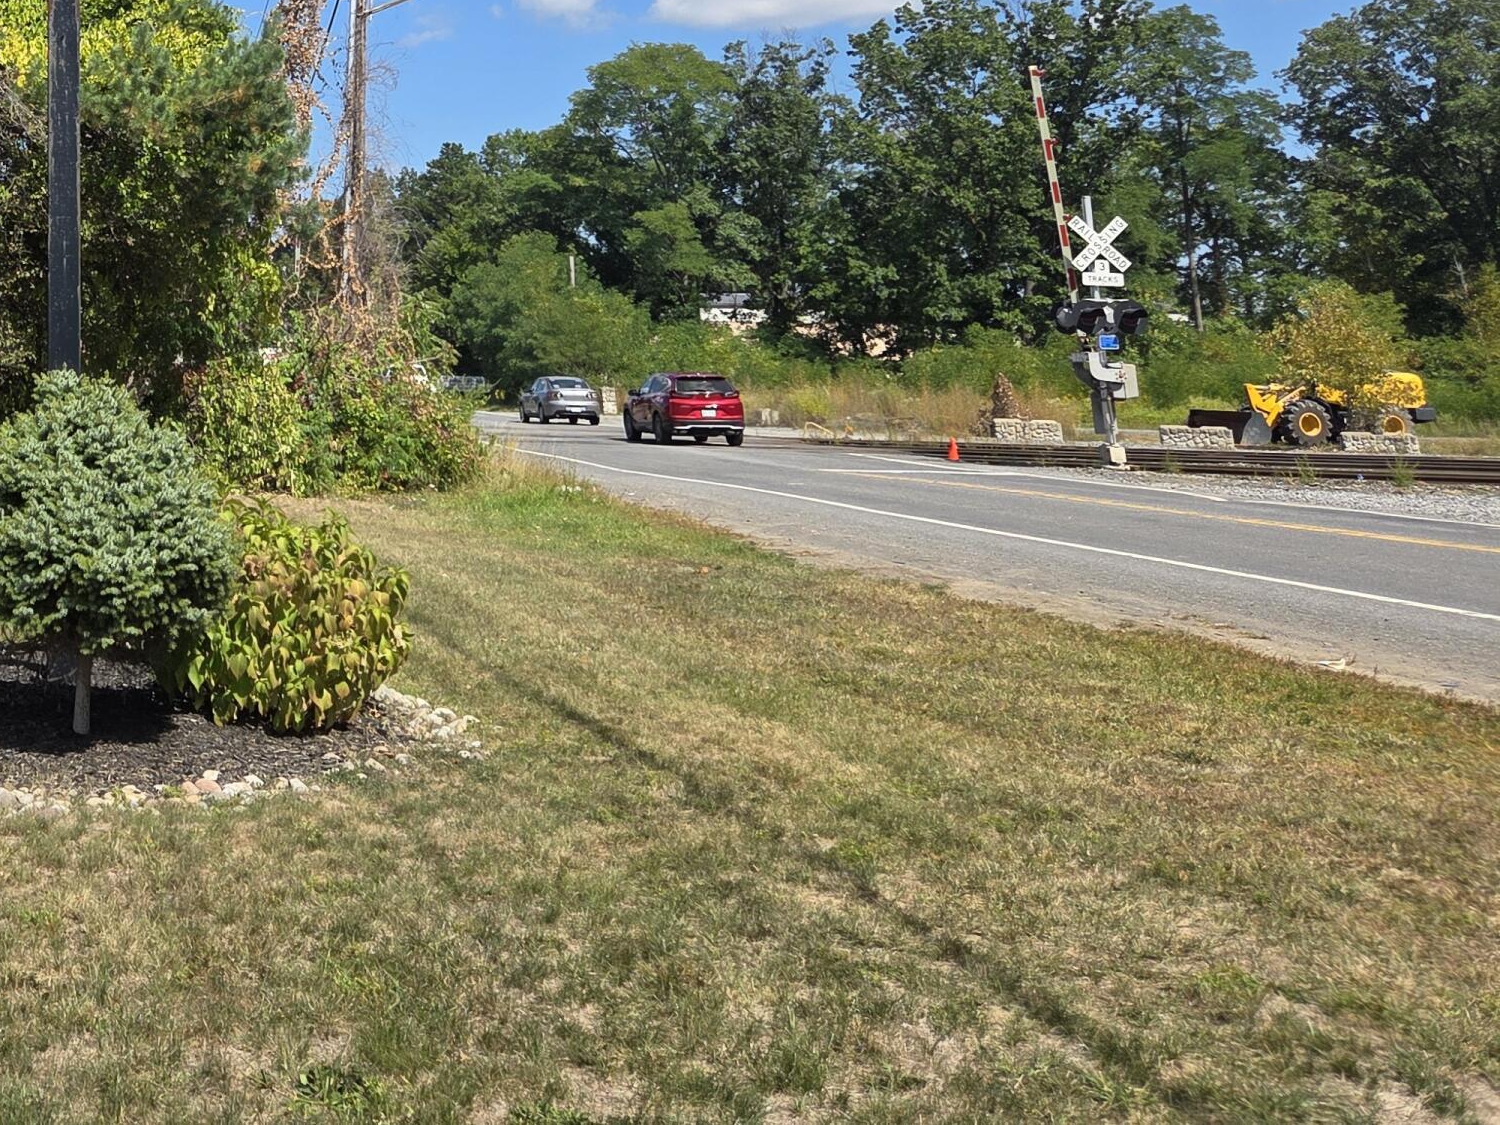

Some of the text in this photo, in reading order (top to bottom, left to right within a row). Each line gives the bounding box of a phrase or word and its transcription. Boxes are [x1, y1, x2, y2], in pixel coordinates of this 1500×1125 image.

[1075, 219, 1124, 268] CROSSING
[1099, 262, 1106, 271] 3
[1087, 275, 1119, 283] TRACKS
